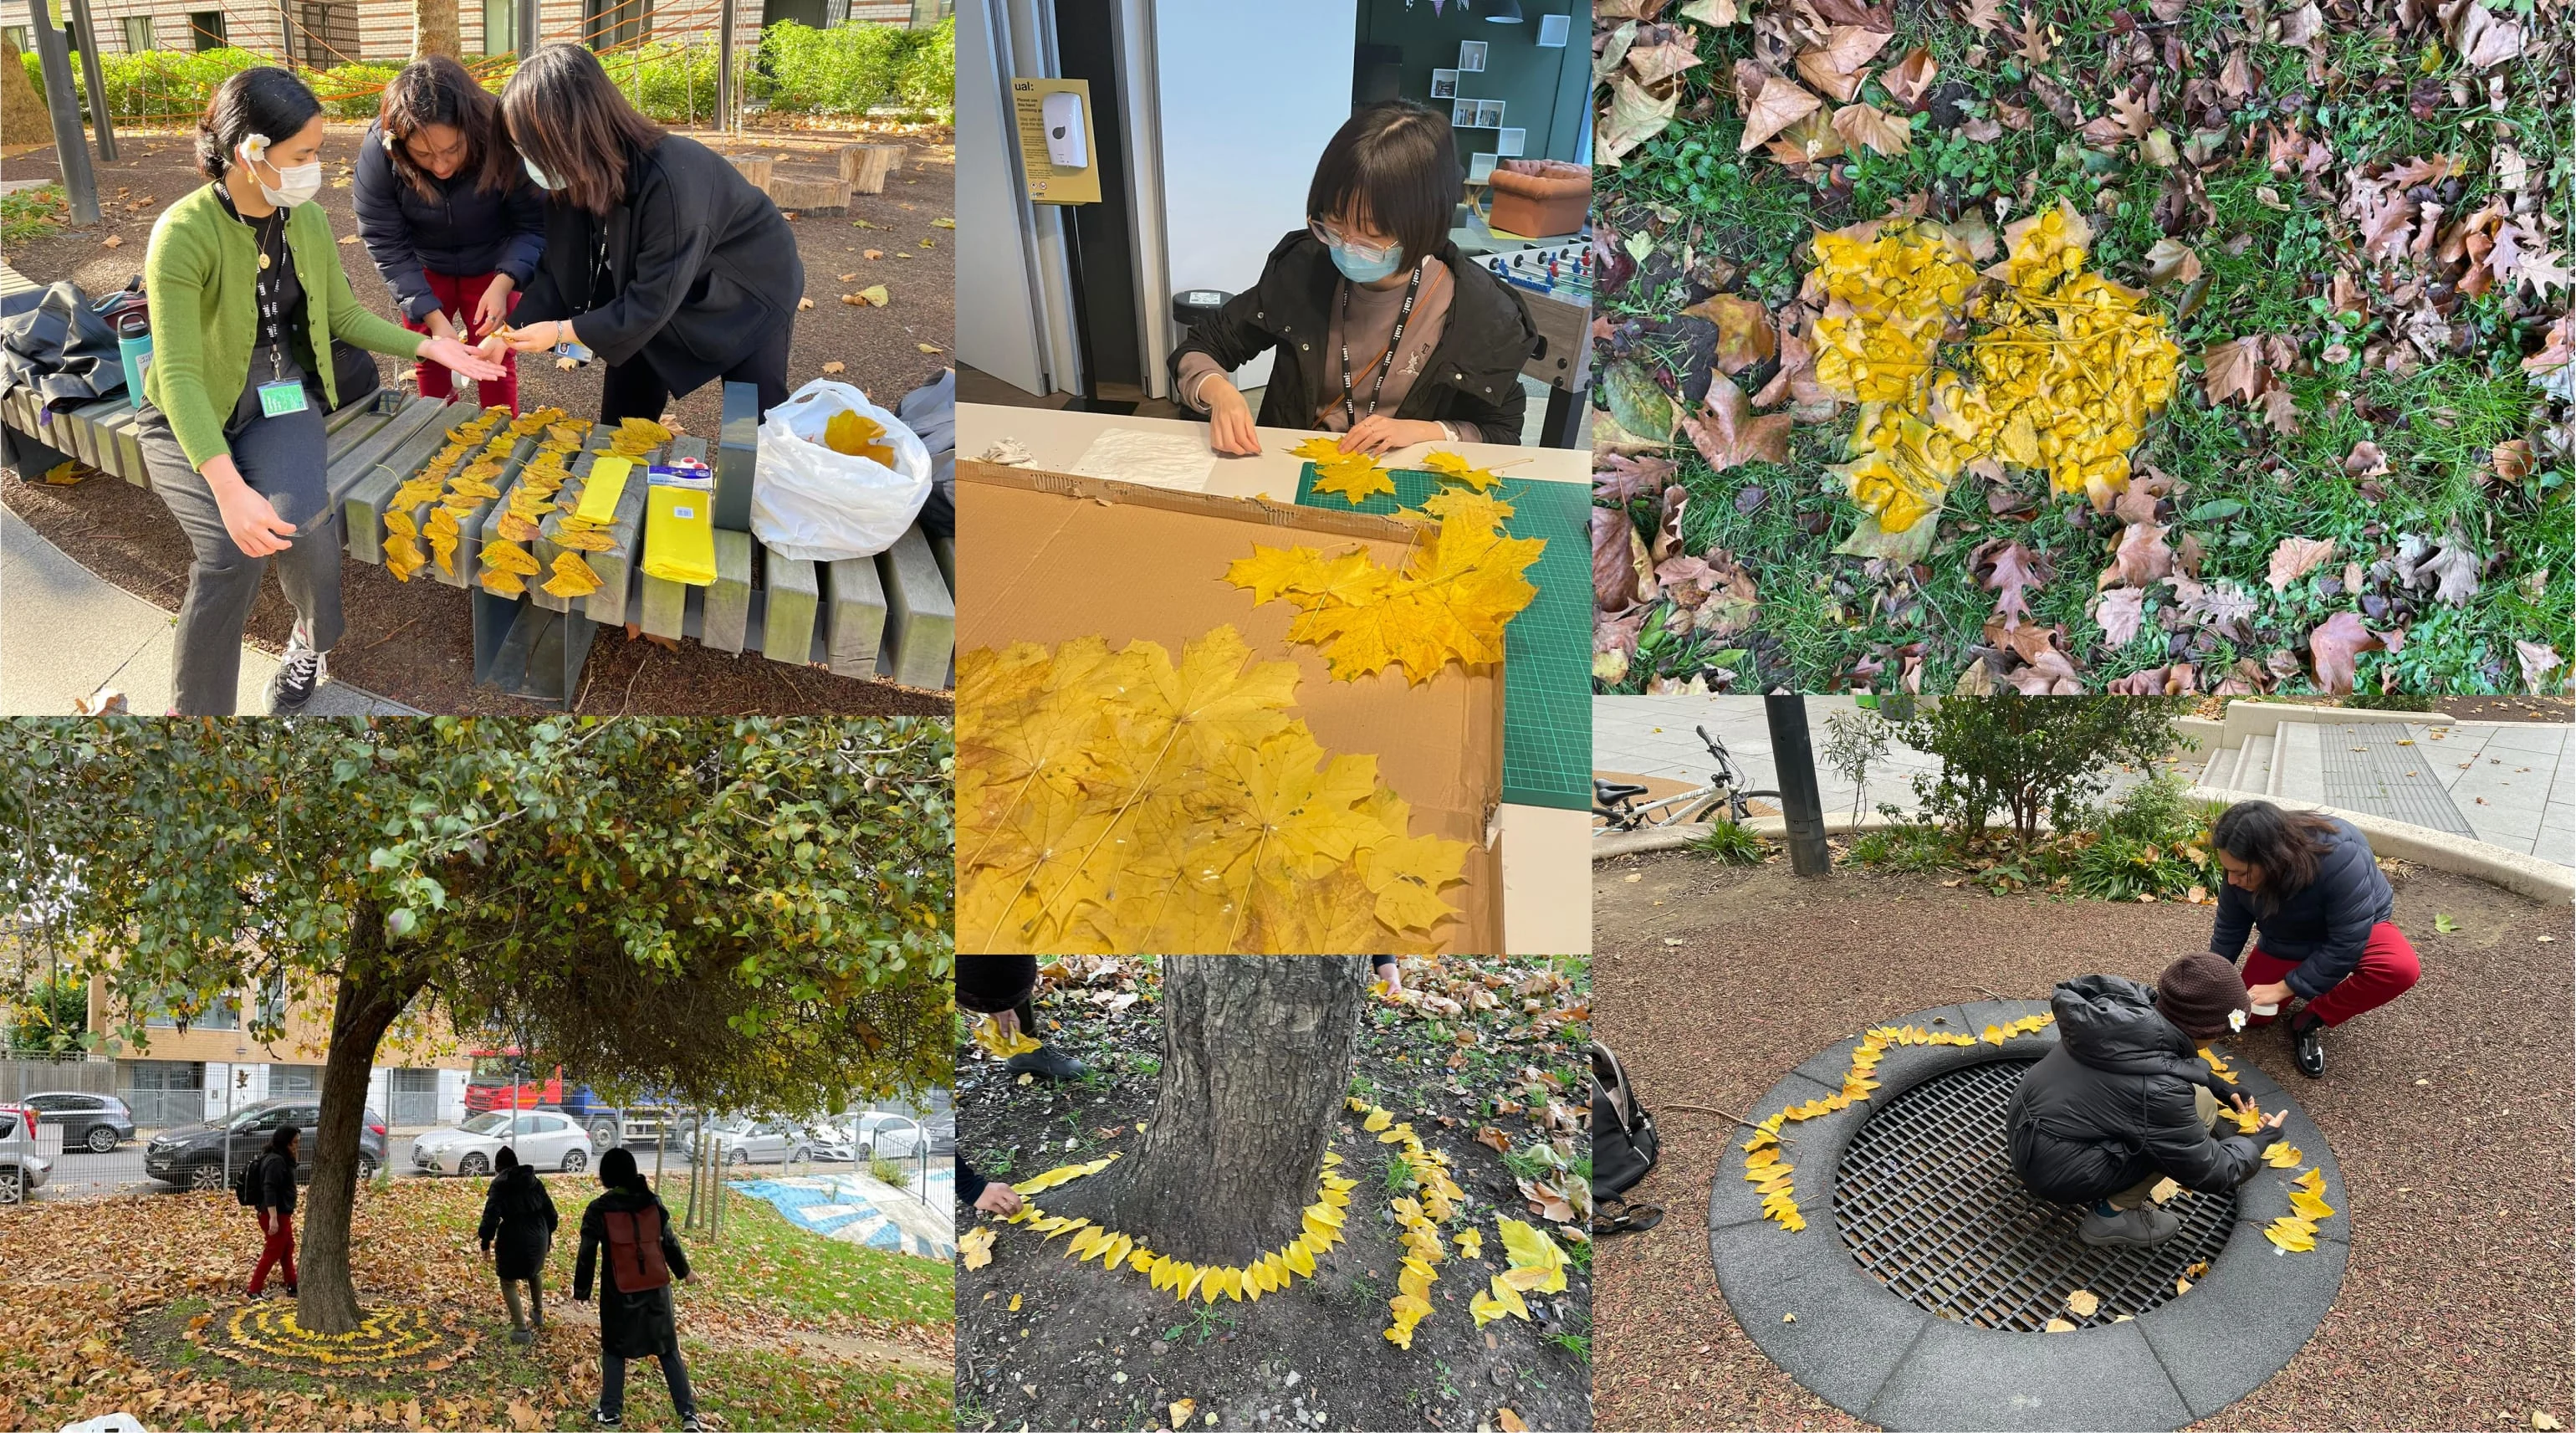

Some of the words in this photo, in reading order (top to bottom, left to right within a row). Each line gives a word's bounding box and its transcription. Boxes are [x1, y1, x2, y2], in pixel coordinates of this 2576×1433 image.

[1015, 81, 1034, 91] ual:
[1411, 269, 1420, 286] ual:
[257, 282, 267, 296] ual:
[262, 304, 271, 318] ual:
[1402, 296, 1413, 314] ual:
[1393, 324, 1403, 340] ual:
[1383, 351, 1393, 366] ual:
[1342, 371, 1351, 388] ual:
[1373, 376, 1383, 391] ual:
[1346, 398, 1354, 414] ual:
